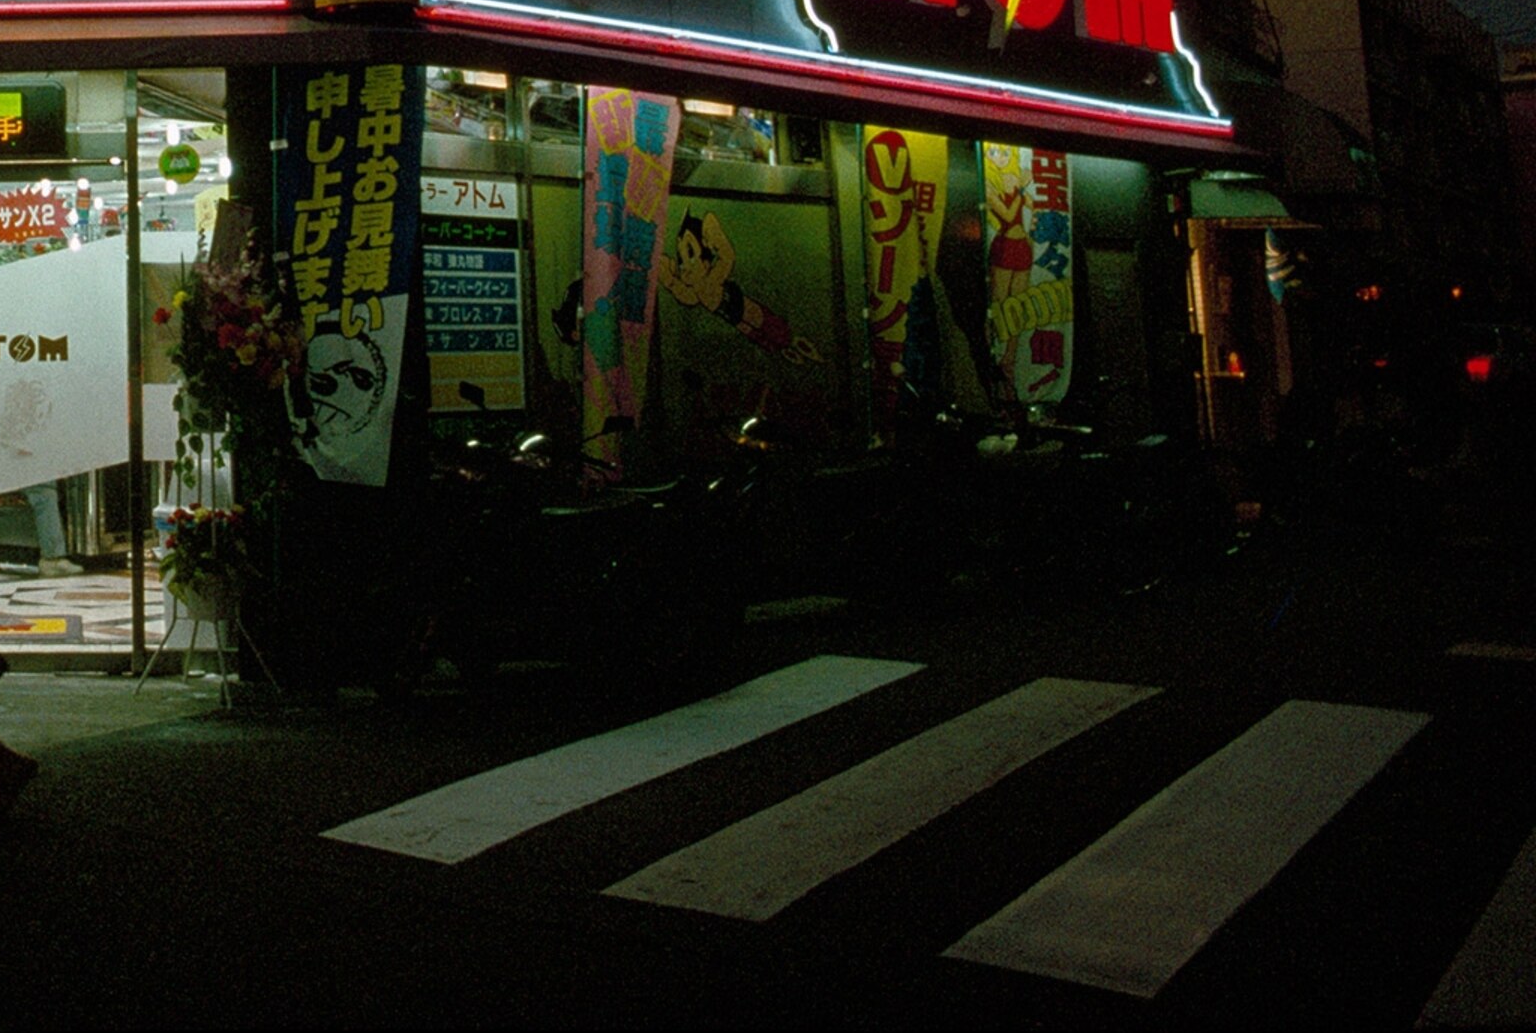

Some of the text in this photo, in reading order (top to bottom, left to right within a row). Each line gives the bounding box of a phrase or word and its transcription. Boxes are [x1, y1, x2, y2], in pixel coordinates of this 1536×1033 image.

[341, 63, 405, 339] 暑中お見舞い
[453, 180, 505, 209] アトム
